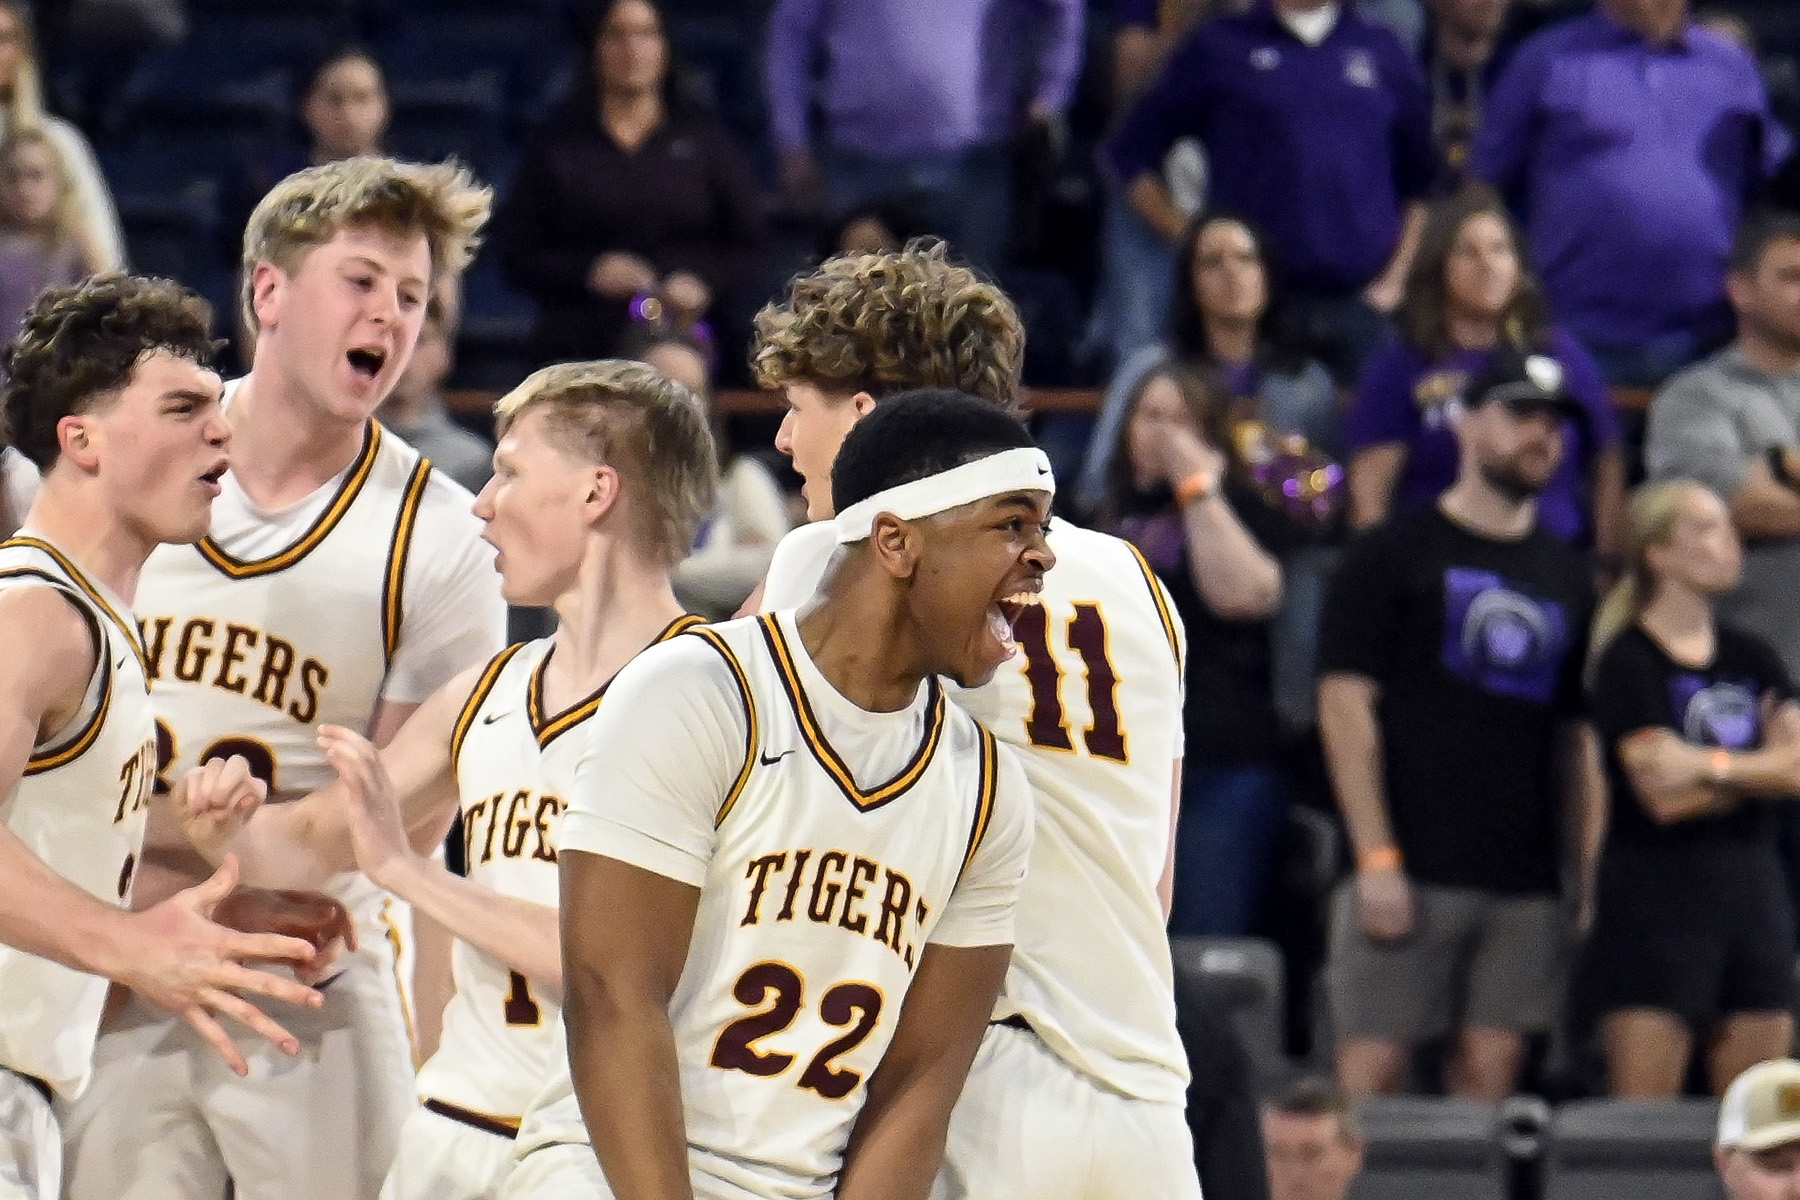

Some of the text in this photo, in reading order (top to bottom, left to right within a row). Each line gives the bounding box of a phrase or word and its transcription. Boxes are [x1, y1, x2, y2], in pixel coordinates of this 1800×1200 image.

[138, 616, 330, 724] IGERS
[1012, 600, 1131, 766] 11
[463, 788, 568, 874] TIGE
[707, 958, 886, 1101] 22
